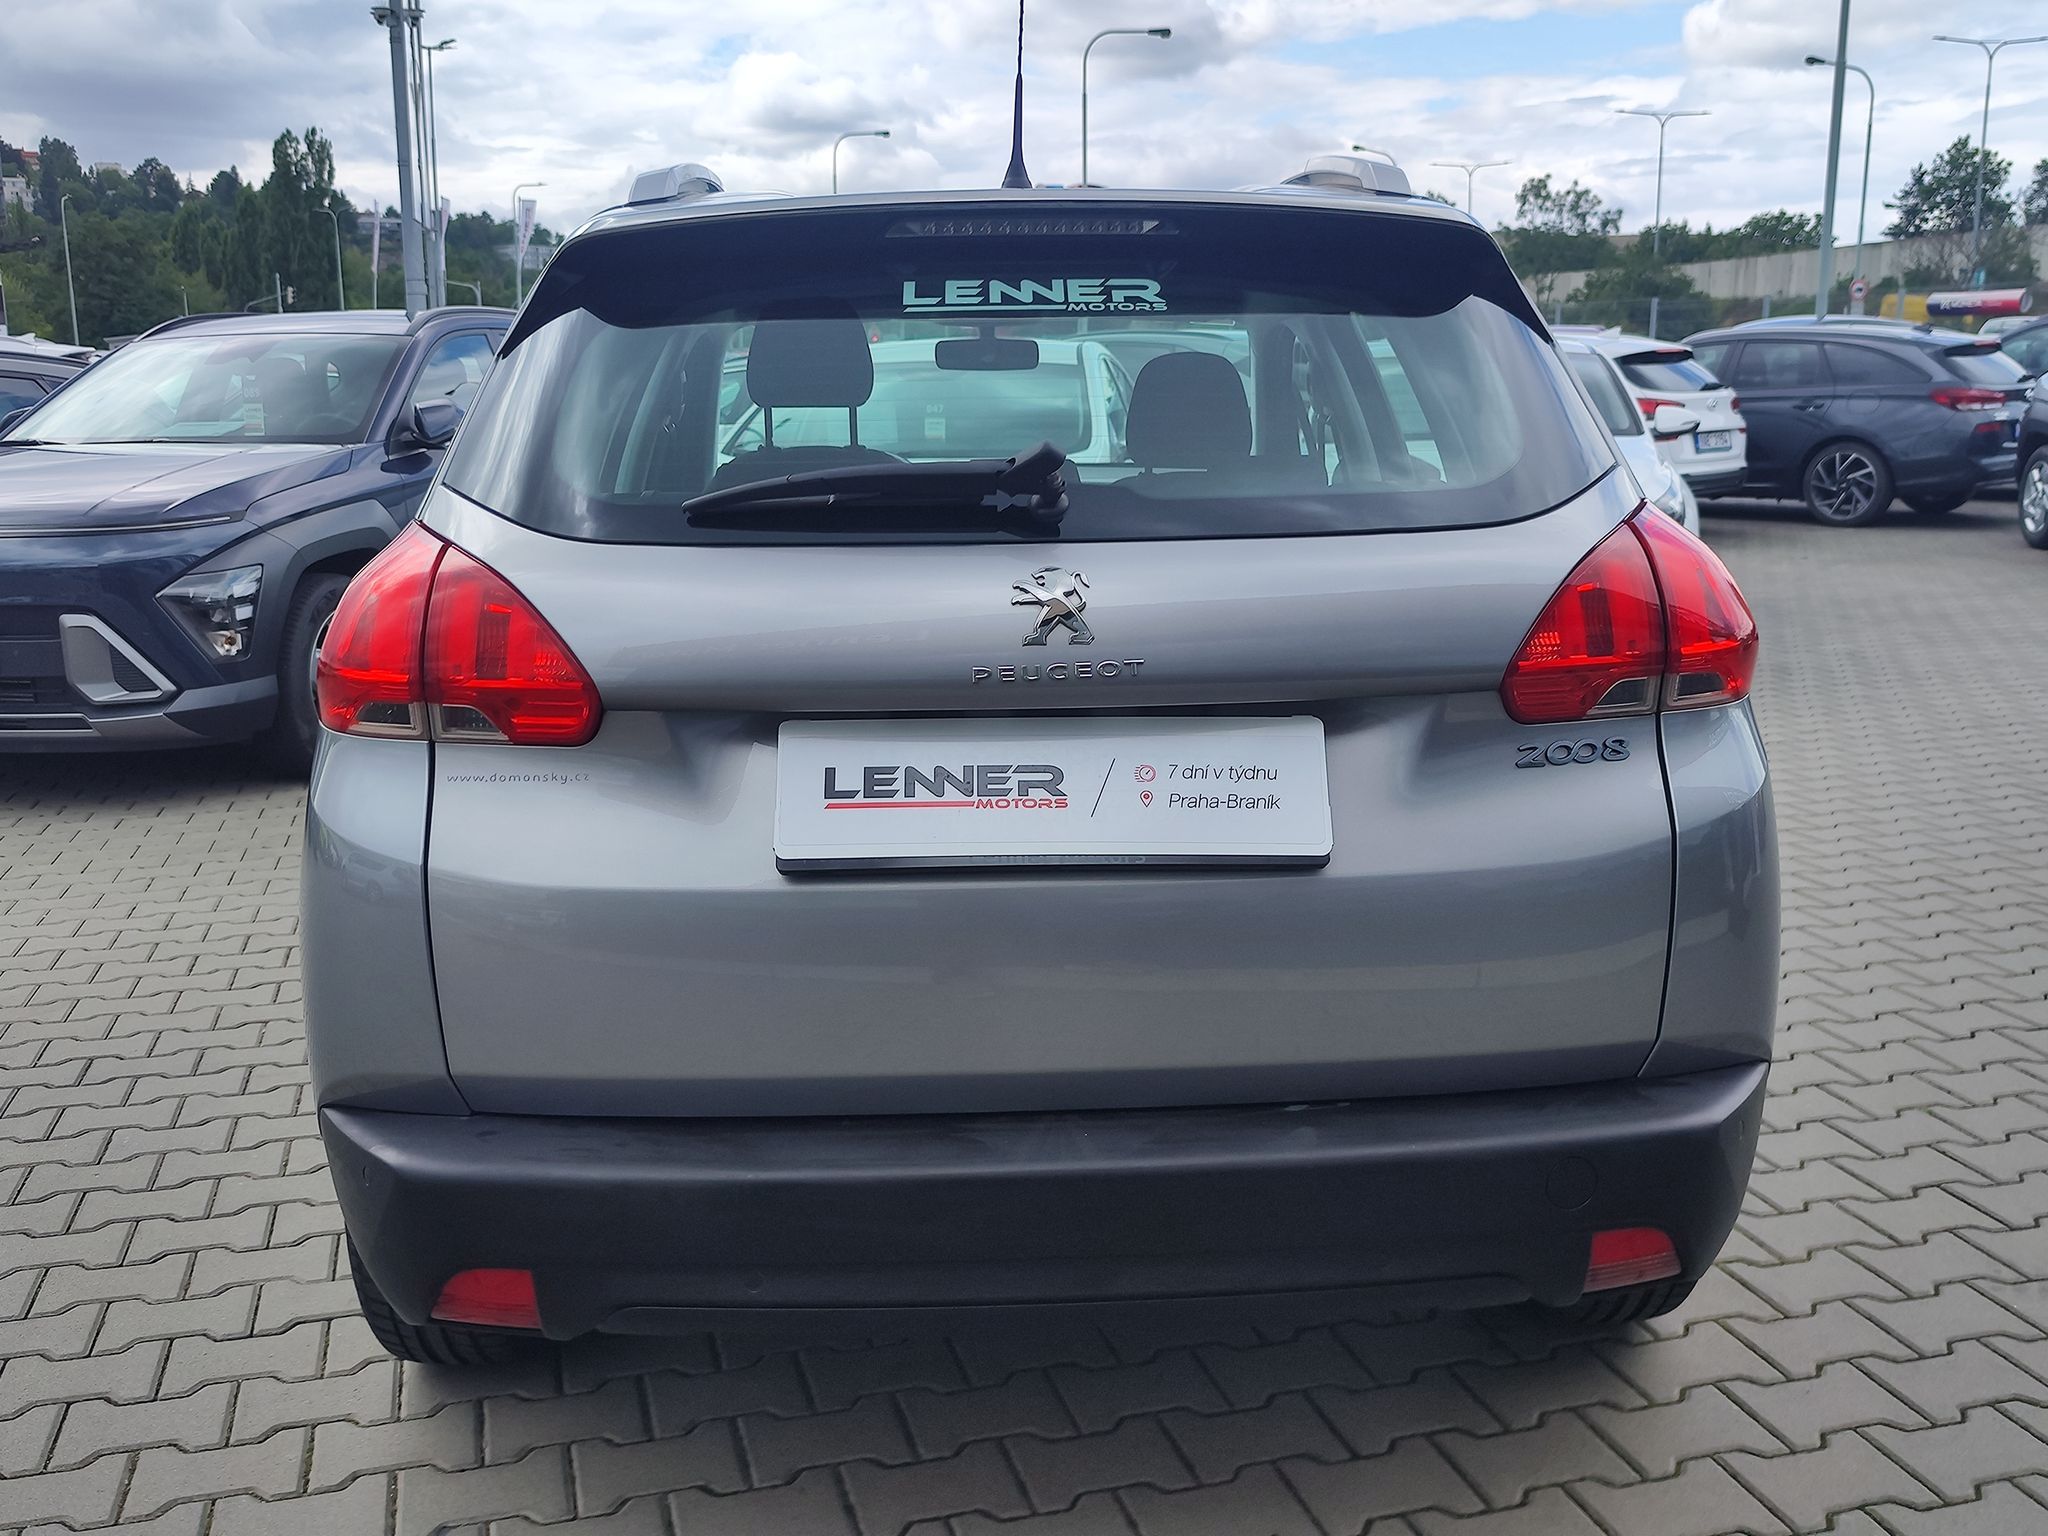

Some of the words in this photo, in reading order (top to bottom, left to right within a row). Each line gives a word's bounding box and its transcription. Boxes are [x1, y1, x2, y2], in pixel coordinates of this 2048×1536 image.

[902, 278, 1167, 305] LENNER
[1067, 302, 1168, 312] MOTORS
[971, 658, 1146, 684] PEUGEOT
[1515, 736, 1631, 769] 2008
[446, 772, 590, 785] www.domonsky.cz
[823, 764, 1069, 799] LENNER
[1168, 764, 1178, 780] 7
[1182, 764, 1210, 780] dní
[1213, 767, 1224, 780] v
[1228, 764, 1278, 783] týdnu
[975, 798, 1069, 809] MOTORS
[1168, 793, 1281, 810] Praha-Braník
